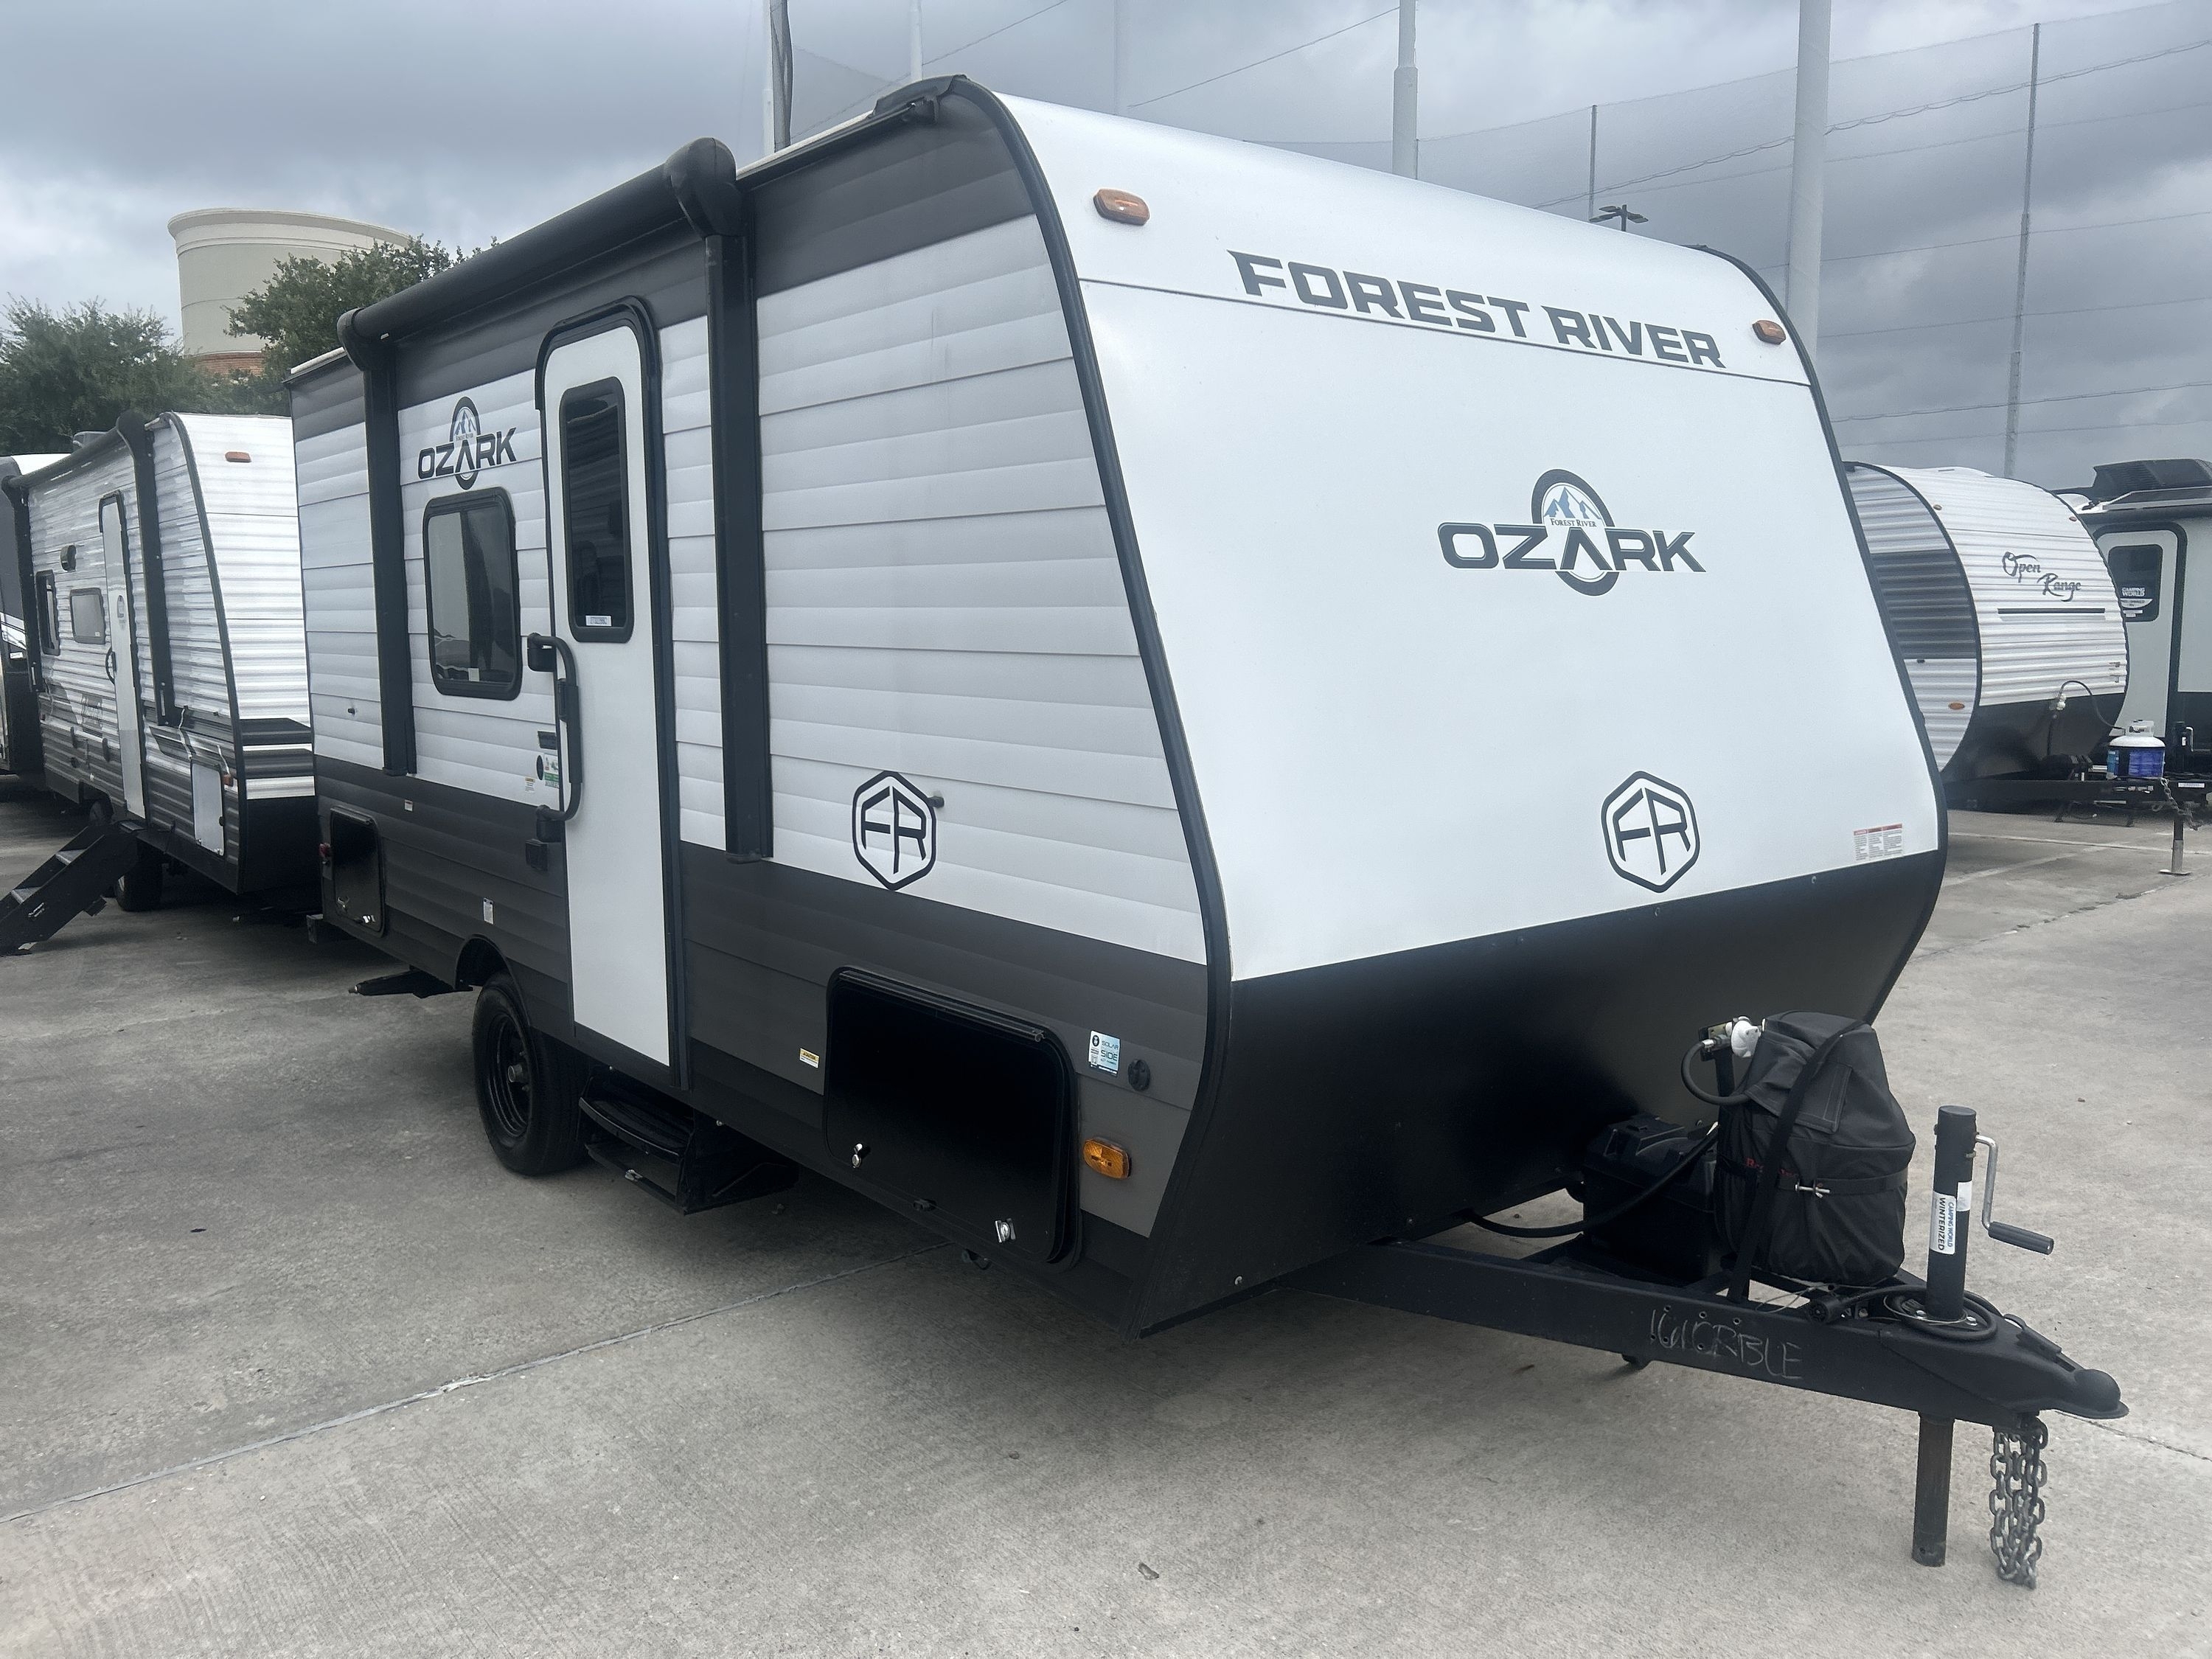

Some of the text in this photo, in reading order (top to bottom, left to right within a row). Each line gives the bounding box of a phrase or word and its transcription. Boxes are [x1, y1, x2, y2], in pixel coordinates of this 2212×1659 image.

[1227, 250, 1726, 369] FOREST RIVER
[418, 428, 517, 479] OZARK
[1550, 518, 1597, 527] FOREST RIVER
[1438, 522, 1707, 573] OZARK
[2002, 552, 2041, 583] Open
[2037, 573, 2081, 602] Range
[1101, 1049, 1118, 1062] SIDE
[1102, 1040, 1119, 1050] SOLAR
[1938, 1197, 1946, 1251] WINTERIZED
